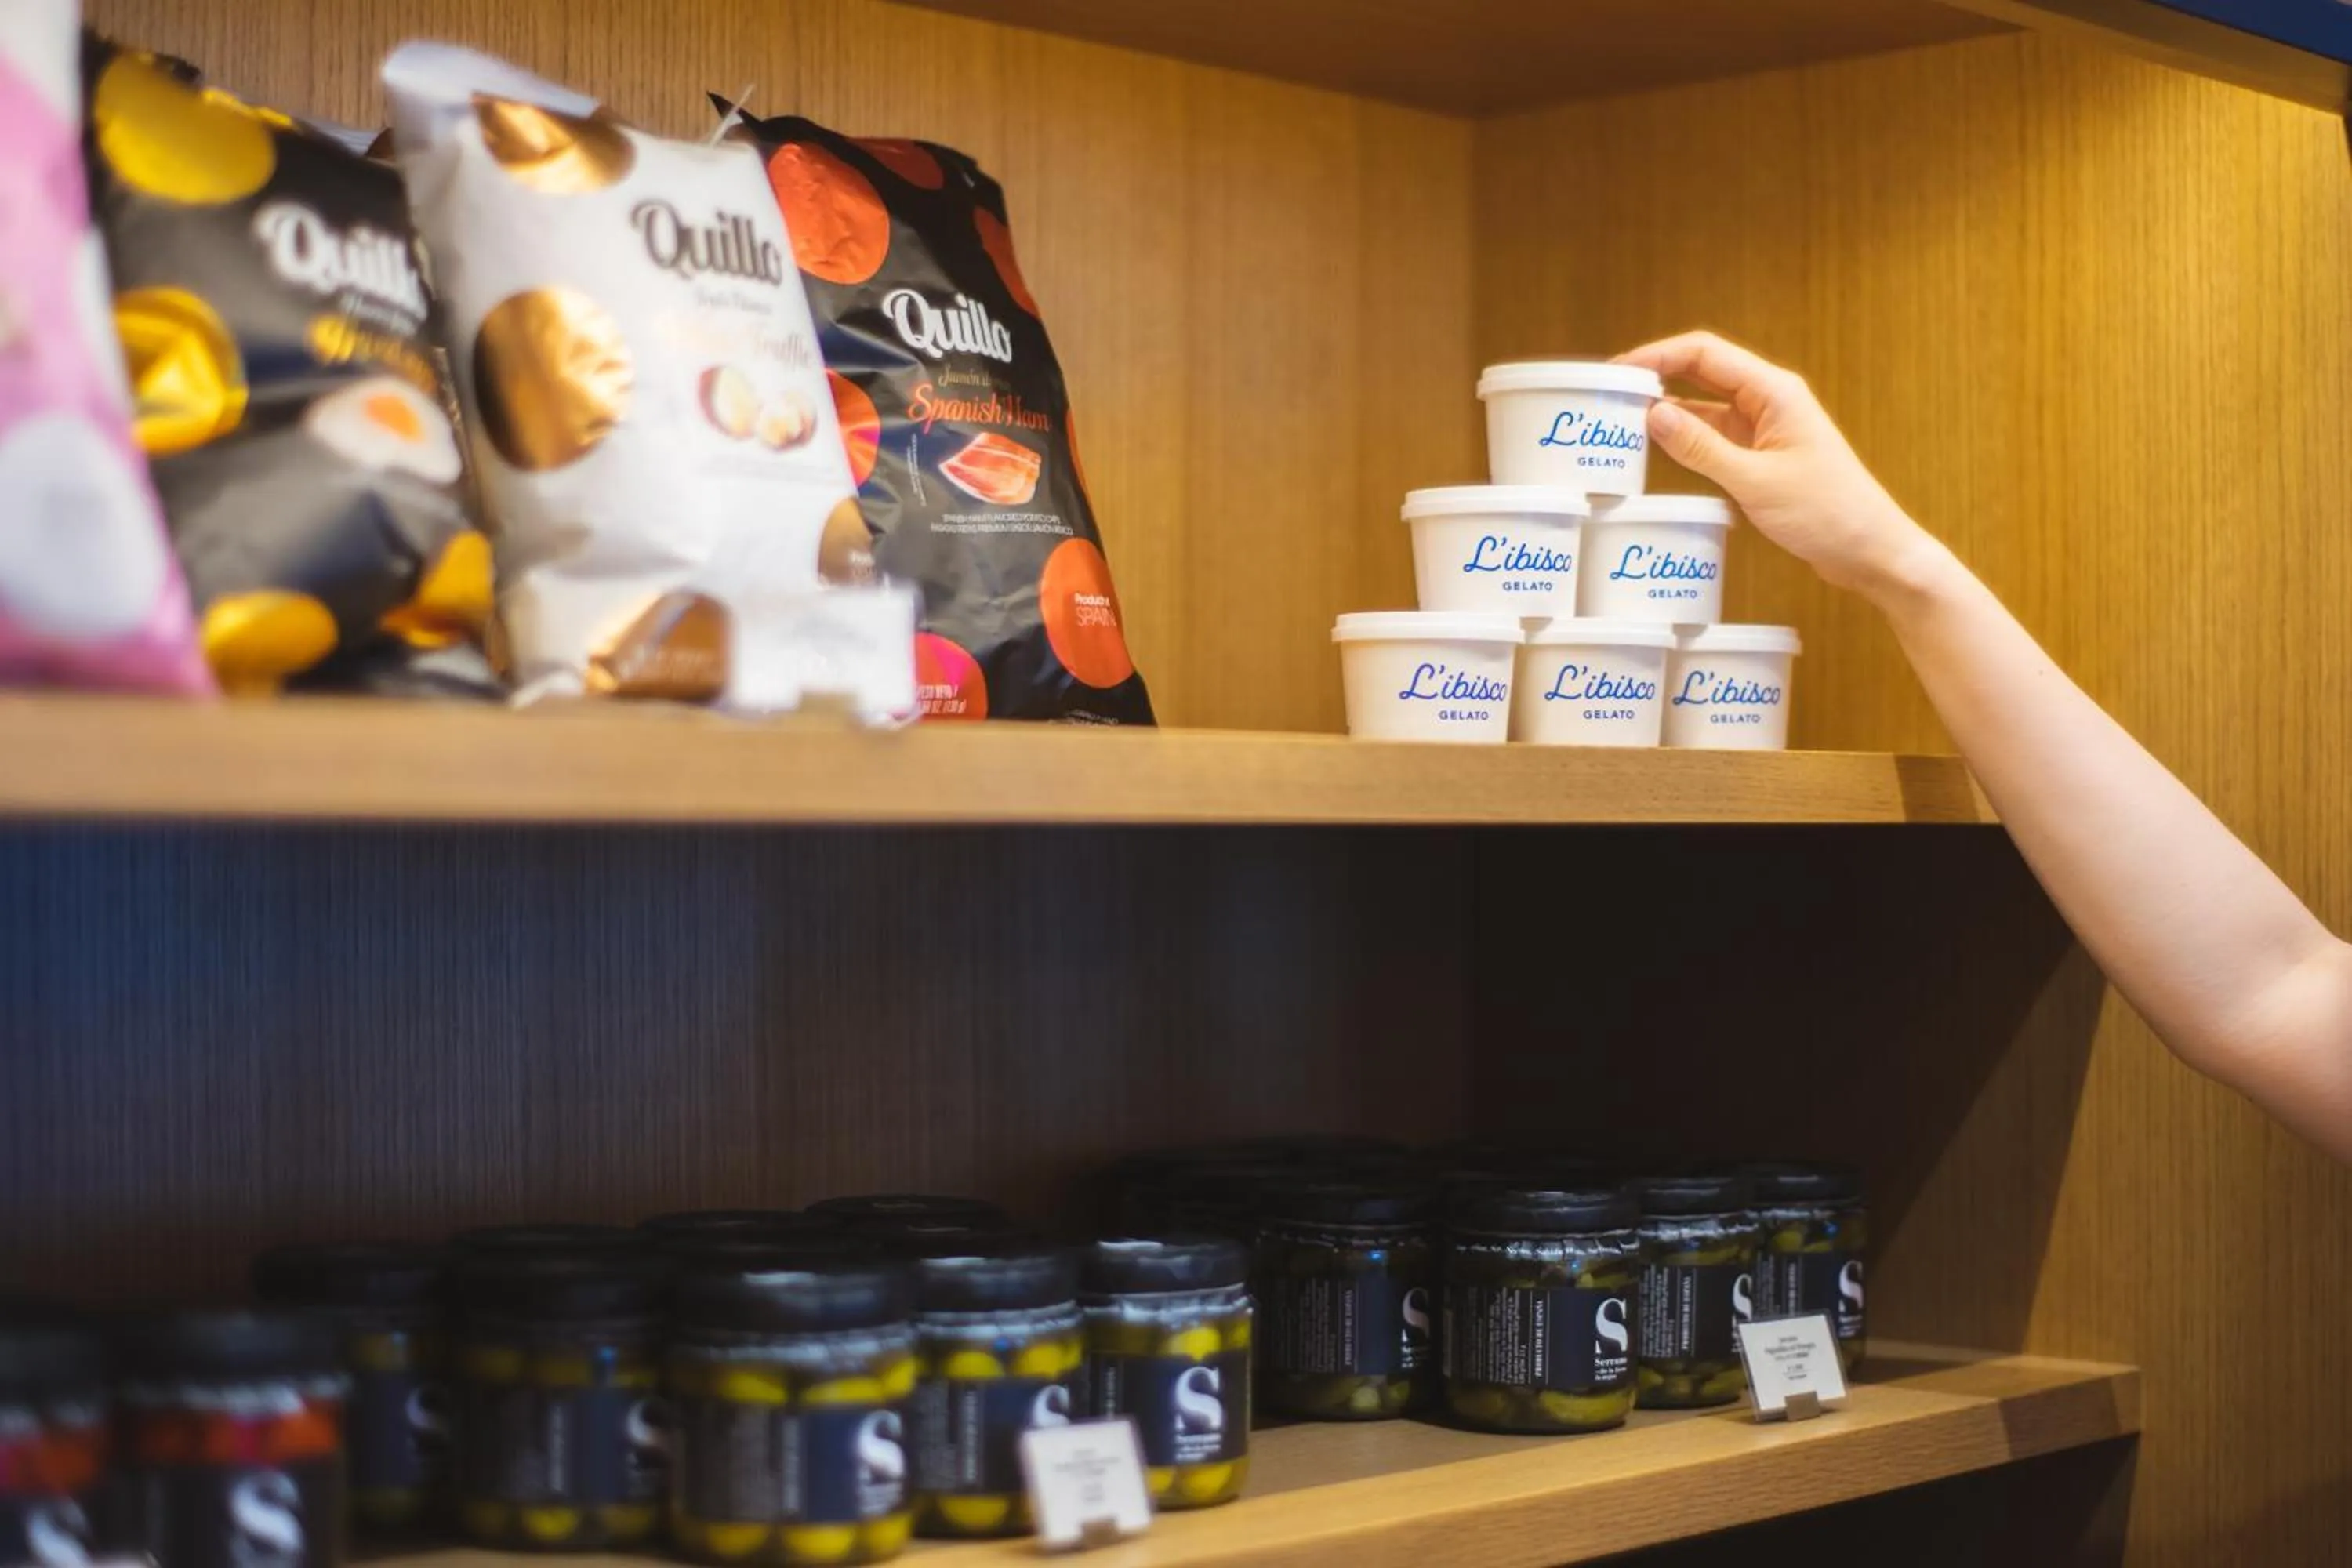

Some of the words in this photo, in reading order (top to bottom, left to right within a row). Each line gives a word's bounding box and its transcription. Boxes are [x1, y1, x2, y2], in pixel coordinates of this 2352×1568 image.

[630, 198, 783, 288] Quillo
[881, 288, 1013, 363] Quillo
[908, 383, 1001, 434] Spanish
[1537, 411, 1644, 452] L'ibisco
[1577, 456, 1626, 469] GELATO
[1462, 535, 1572, 573] L'ibisco
[1609, 544, 1717, 581] L'ibisco
[1501, 580, 1553, 592] GELATO
[1647, 588, 1698, 599] GELATO
[1076, 605, 1117, 627] SPAIN
[1398, 662, 1507, 702] L'ibisco
[1544, 664, 1656, 702] L'ibisco
[1672, 670, 1780, 706] L'ibisco
[1438, 710, 1490, 721] GELATO
[1582, 710, 1635, 720] GELATO
[1710, 713, 1761, 724] GELATO
[1595, 1298, 1628, 1354] S
[1175, 1365, 1223, 1431] S
[857, 1409, 907, 1483] S
